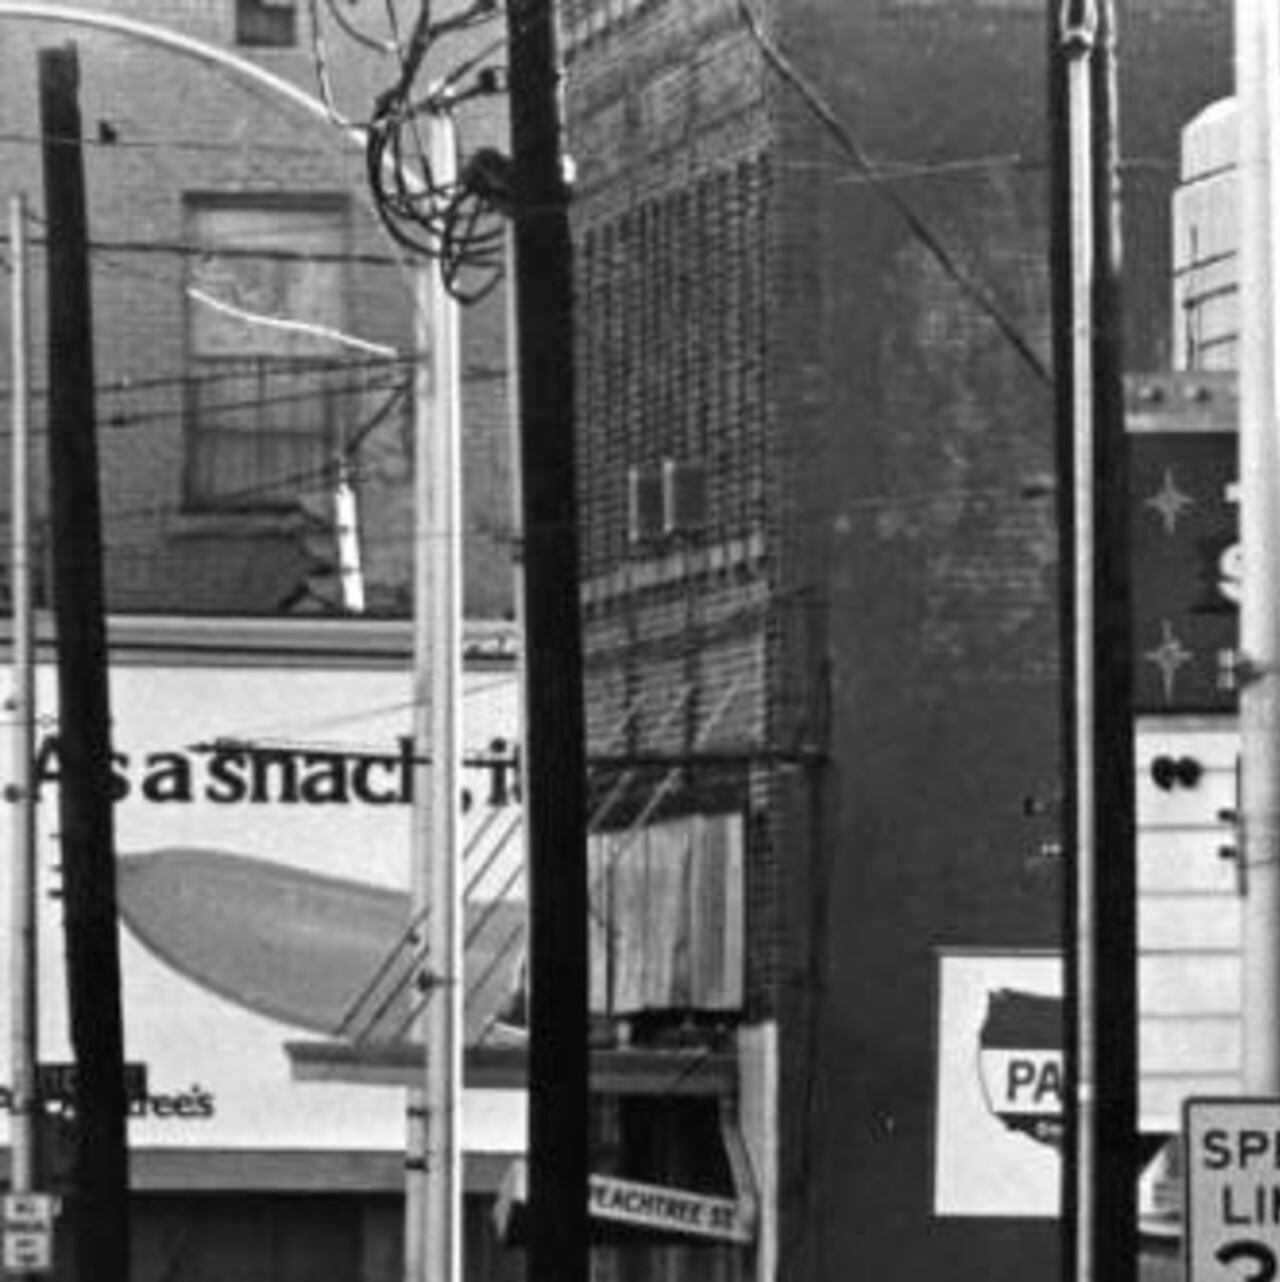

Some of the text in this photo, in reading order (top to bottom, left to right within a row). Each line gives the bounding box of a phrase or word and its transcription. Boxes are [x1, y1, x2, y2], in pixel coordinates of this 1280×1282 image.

[142, 751, 193, 804] a
[1006, 1060, 1062, 1103] PA
[596, 1184, 702, 1225] EACHTREE
